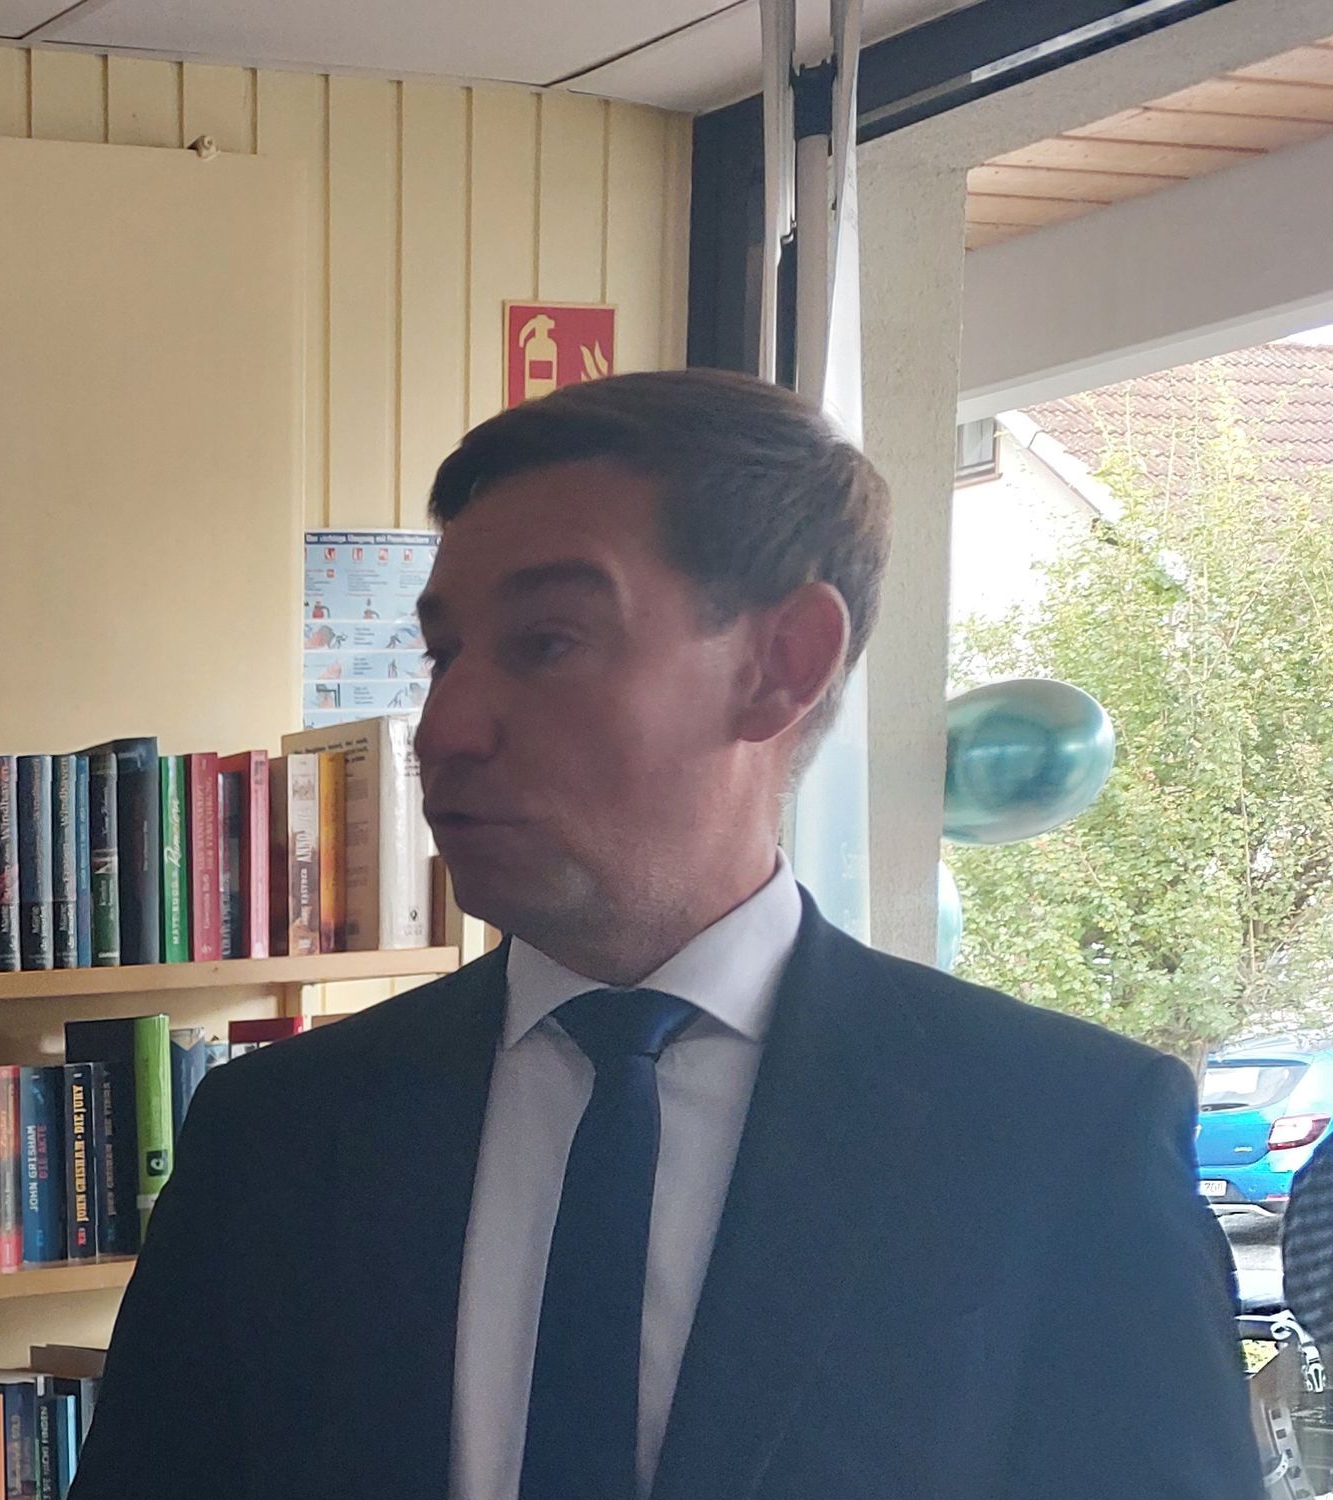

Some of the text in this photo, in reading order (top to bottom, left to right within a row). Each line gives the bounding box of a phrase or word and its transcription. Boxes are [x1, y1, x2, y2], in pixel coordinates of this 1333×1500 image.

[26, 1124, 38, 1213] JOHN GRISHAM
[73, 1083, 89, 1222] JOHN GRISHAM DIE JURY
